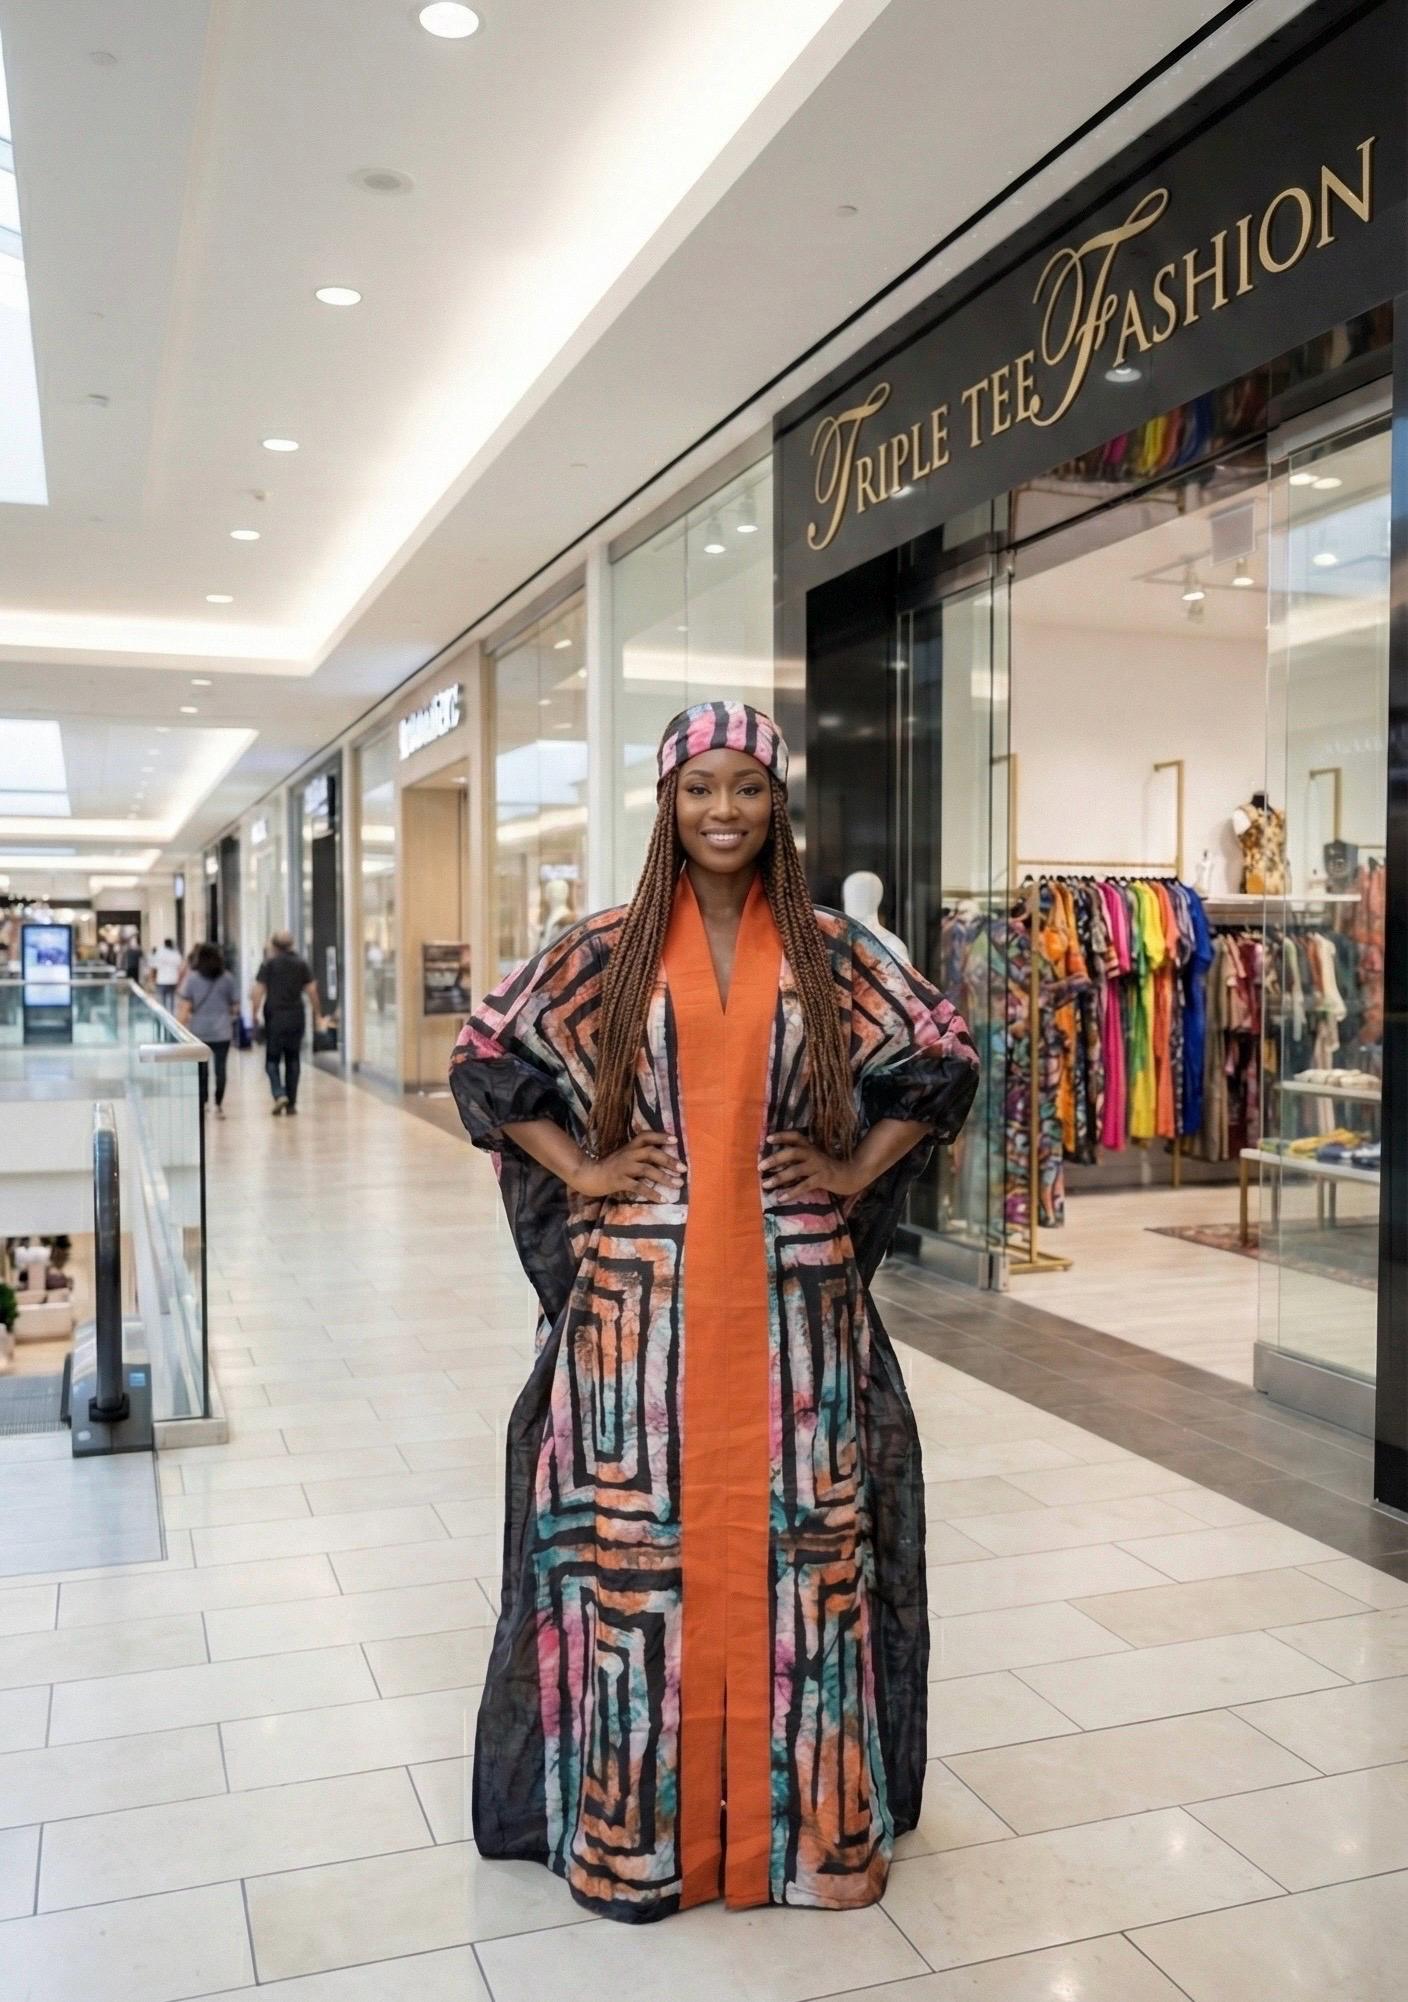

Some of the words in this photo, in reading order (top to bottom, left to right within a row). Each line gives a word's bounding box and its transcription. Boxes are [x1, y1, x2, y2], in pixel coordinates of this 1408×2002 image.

[807, 382, 949, 550] TRIPLE
[961, 350, 1035, 448] TEE
[1029, 136, 1375, 427] FASHION
